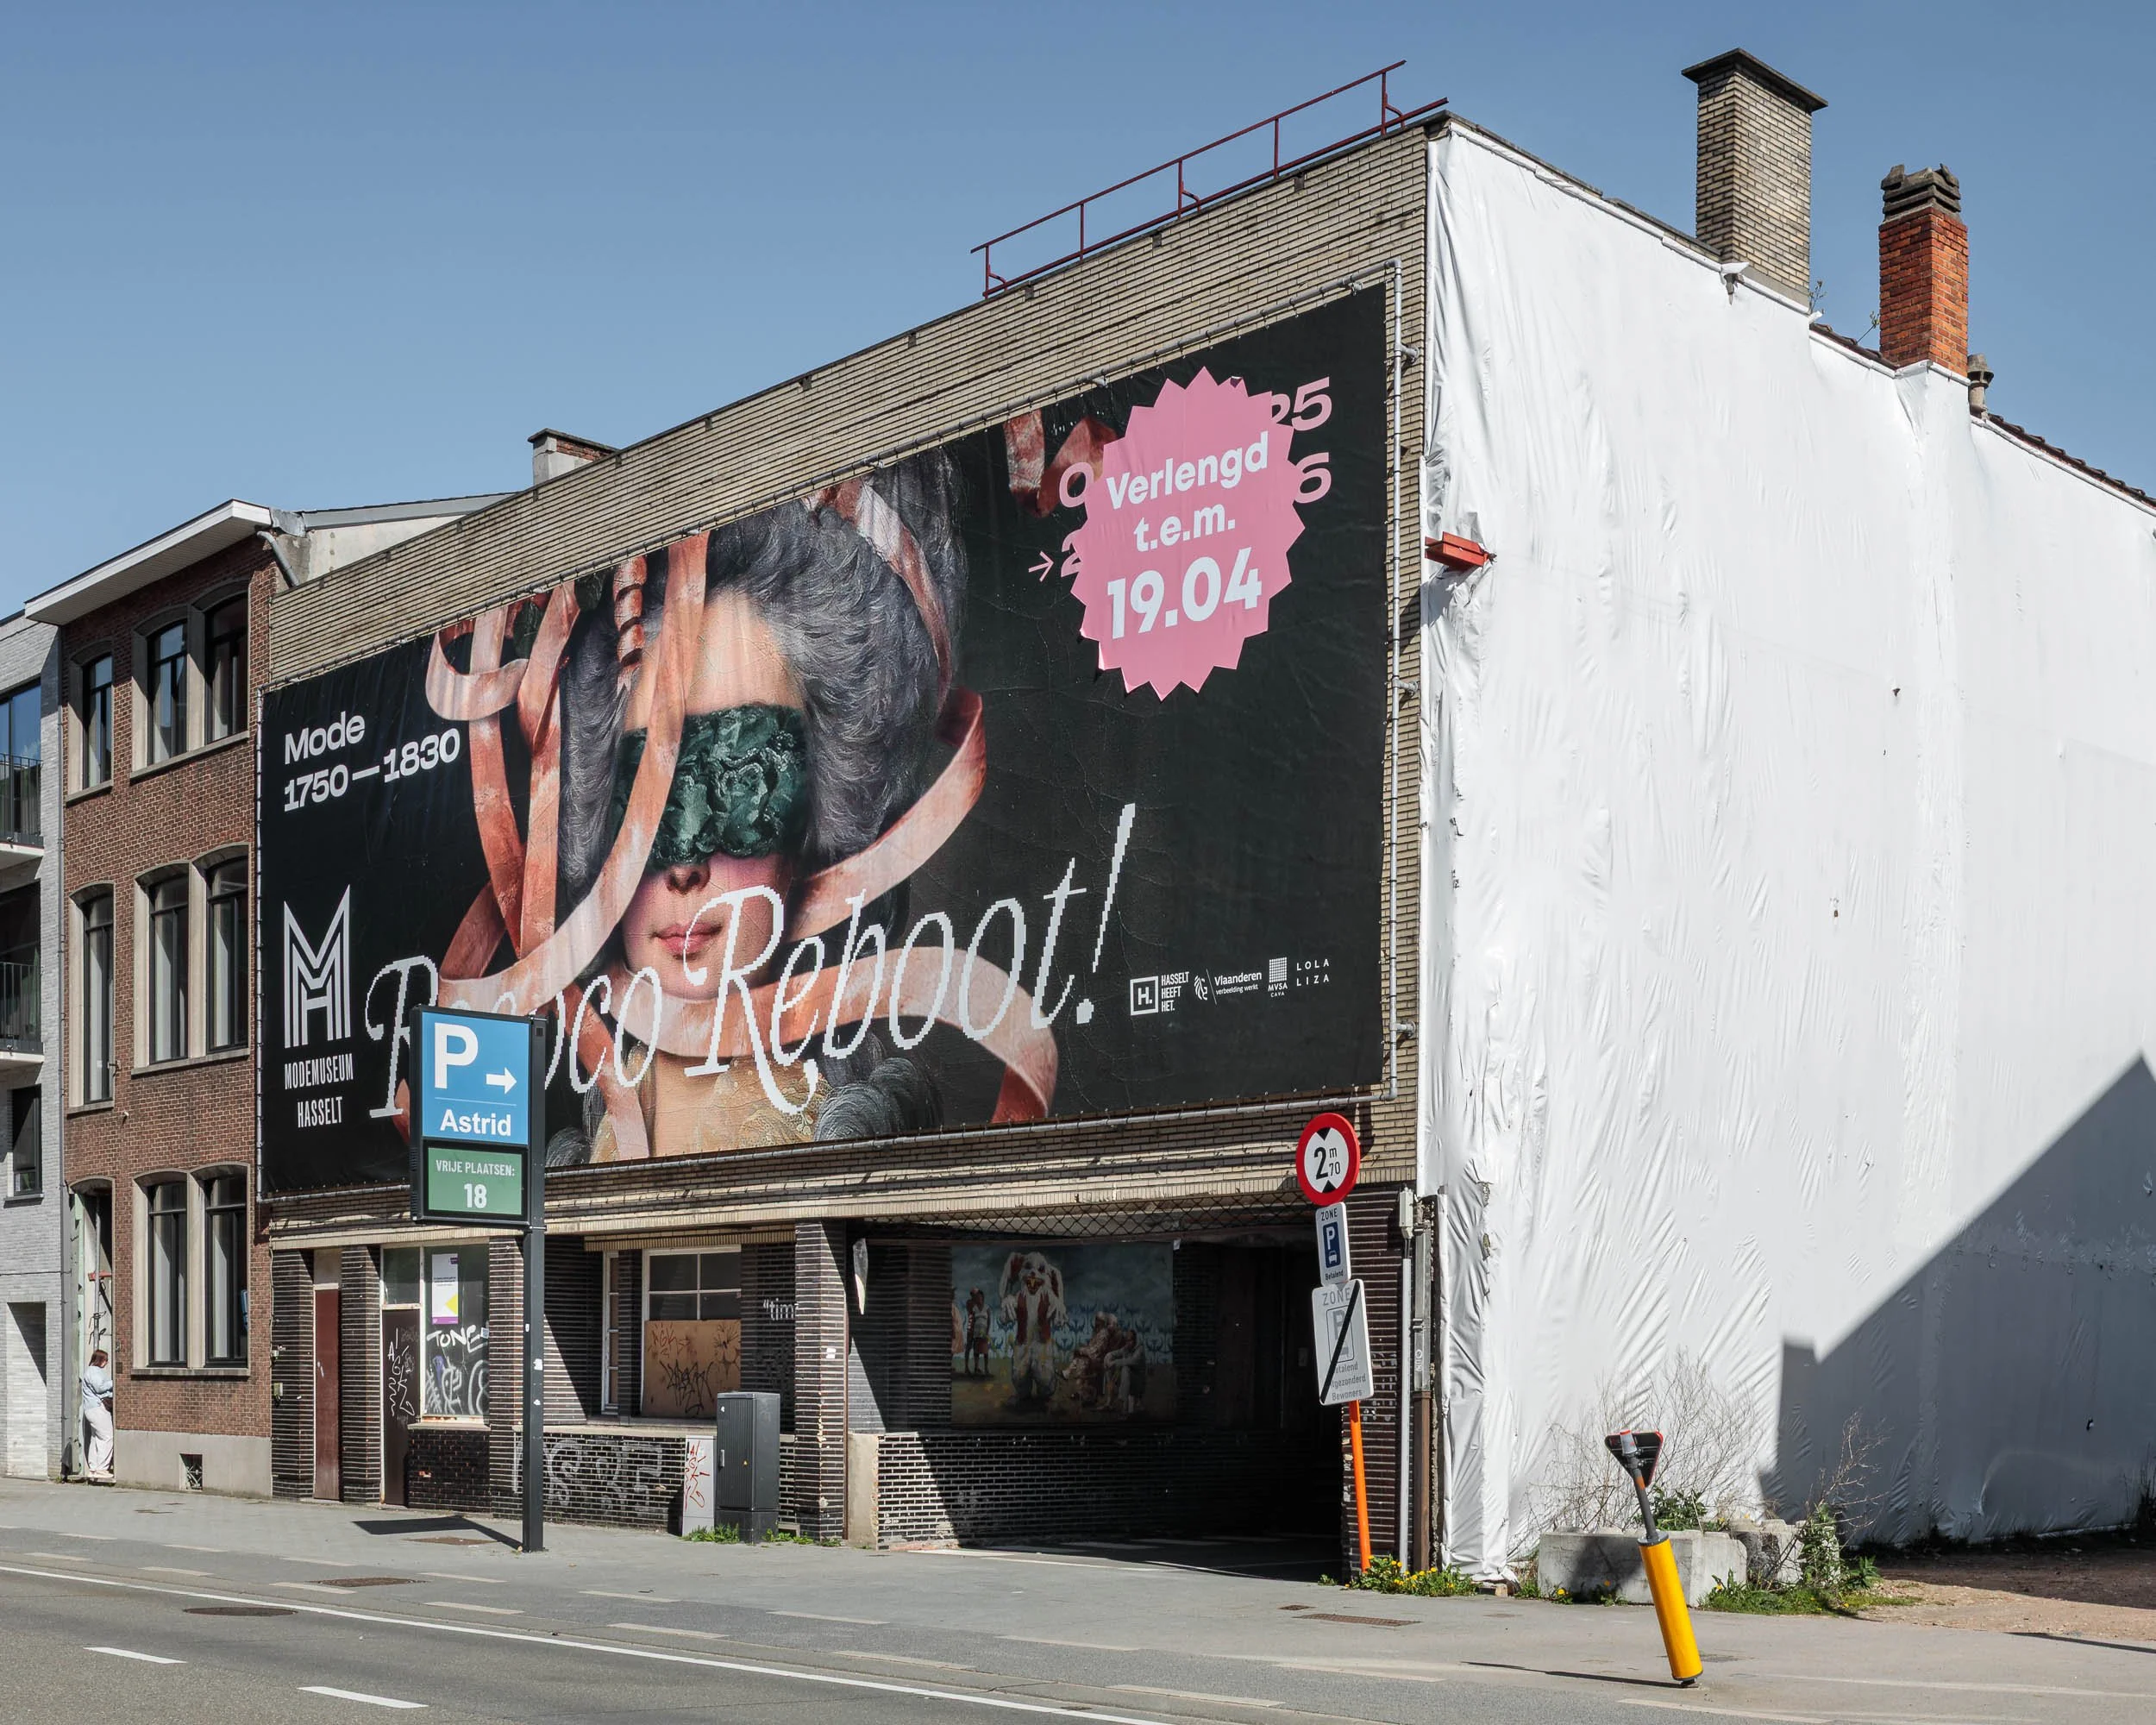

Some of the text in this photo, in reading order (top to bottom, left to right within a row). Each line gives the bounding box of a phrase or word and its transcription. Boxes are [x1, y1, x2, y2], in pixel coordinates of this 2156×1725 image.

[1107, 431, 1269, 510] Verlengd
[1134, 504, 1236, 552] t.e.m.
[1107, 547, 1262, 639] 19.04
[285, 711, 366, 765] Mode
[684, 803, 1135, 1114] Reboot!
[1161, 971, 1189, 987] HASSELT
[1214, 972, 1263, 986] Vlaanderen
[1268, 982, 1288, 992] MVSA
[1161, 986, 1181, 1000] HEEFT
[1216, 983, 1258, 995] verbeelding werkt
[1161, 1000, 1175, 1013] HET.
[434, 1022, 479, 1089] P
[285, 1053, 354, 1090] MODEMUSEUM
[298, 1096, 343, 1128] HASSELT
[440, 1108, 511, 1137] Astrid
[436, 1159, 515, 1176] VRIJE PLAATSEN:
[463, 1183, 487, 1208] 18
[1321, 1208, 1338, 1221] ZONE
[1326, 1226, 1335, 1251] P
[1325, 1270, 1344, 1281] Betalend
[1322, 1287, 1351, 1306] ZONE
[1333, 1362, 1358, 1374] etalend
[1332, 1389, 1363, 1402] Bewoners
